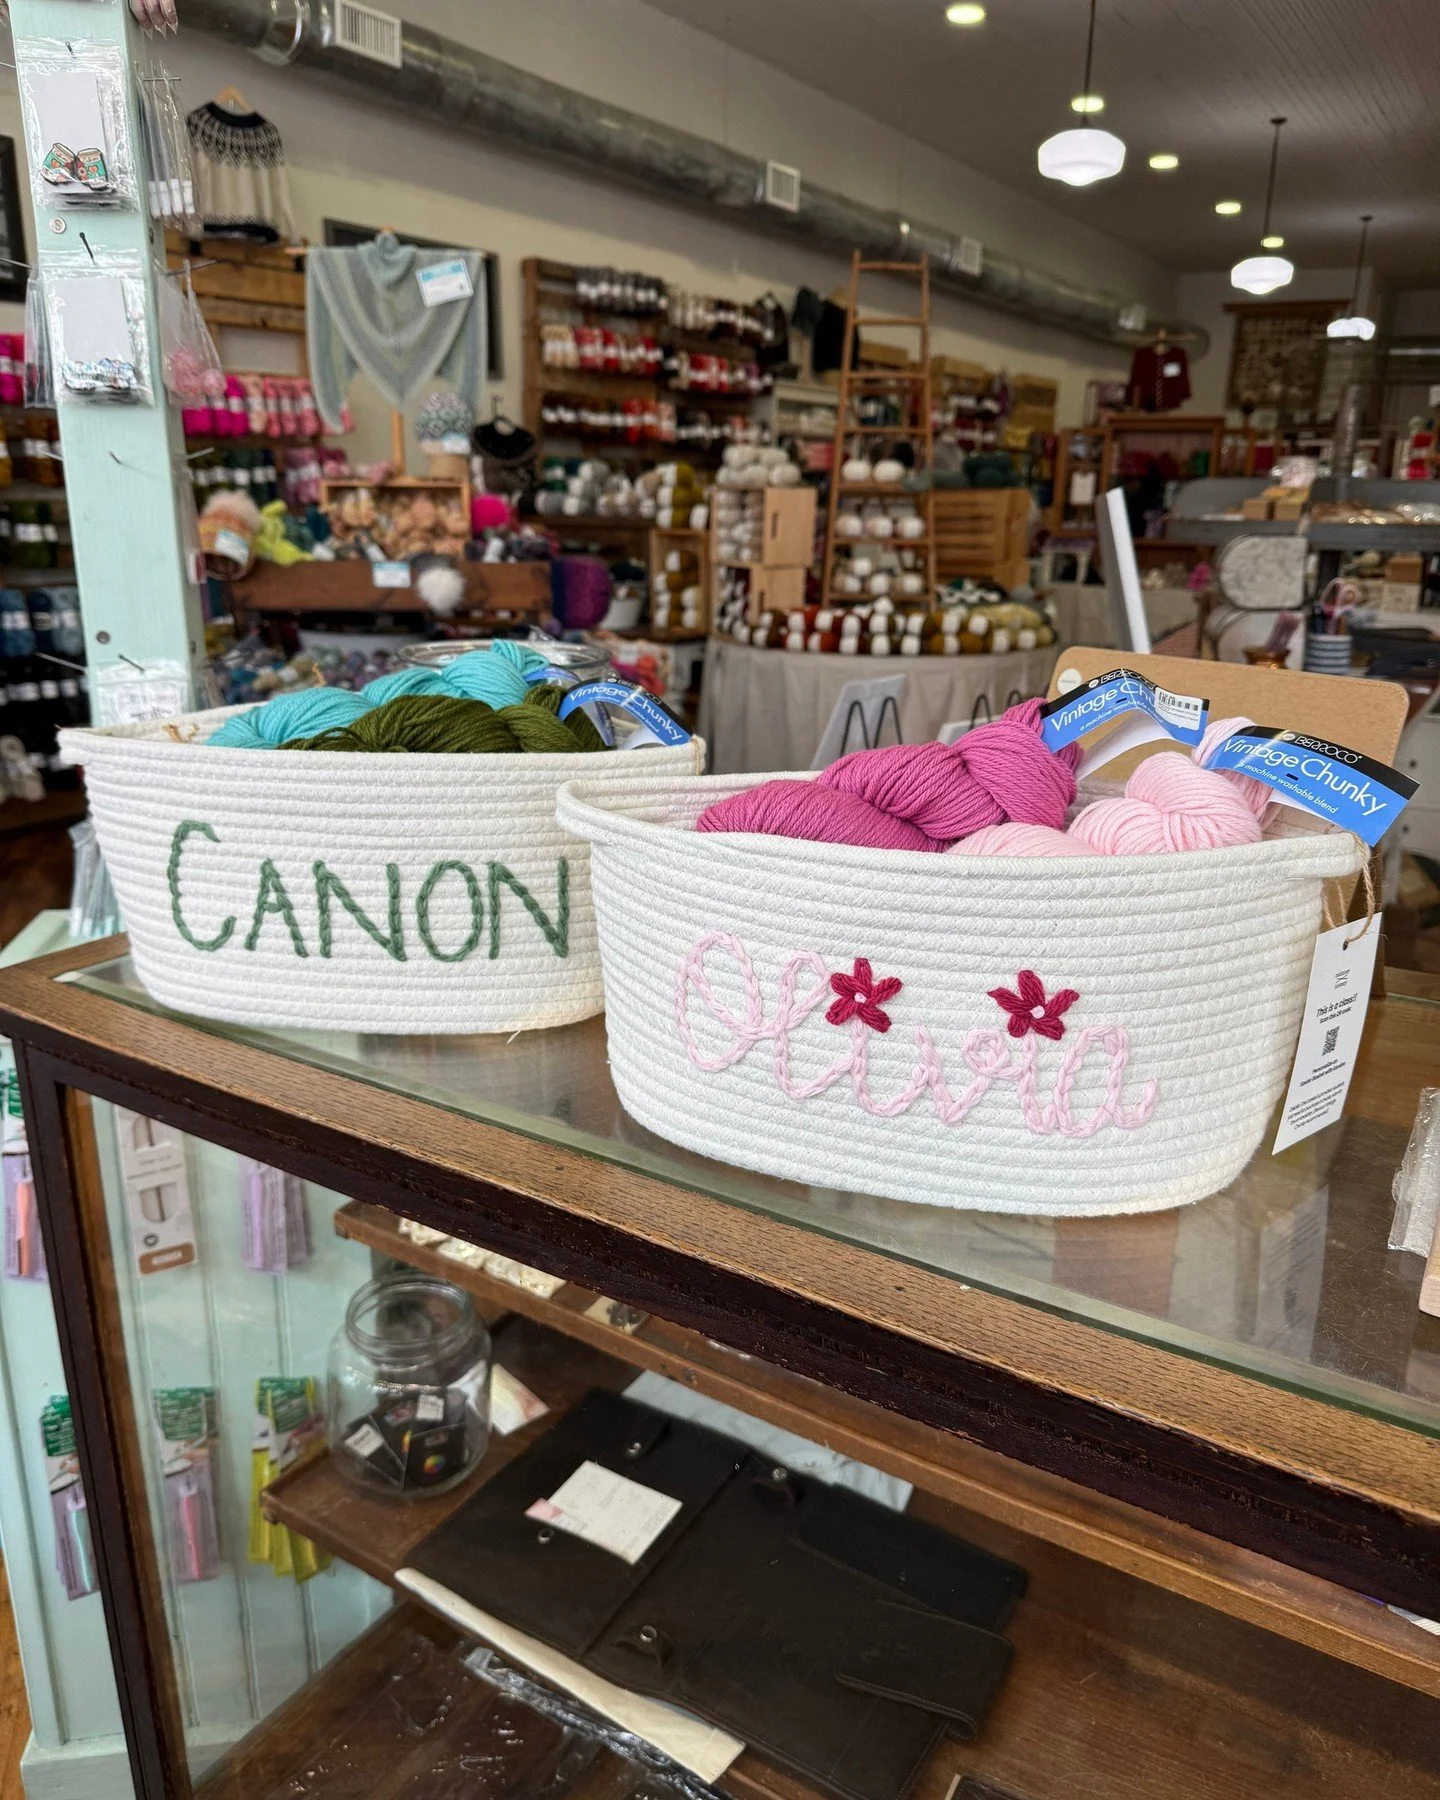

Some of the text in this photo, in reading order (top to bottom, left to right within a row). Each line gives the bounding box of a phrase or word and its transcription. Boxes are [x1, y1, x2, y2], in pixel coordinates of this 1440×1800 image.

[570, 685, 682, 740] Vintage Chunky
[1051, 689, 1117, 732] Vintage
[1085, 710, 1112, 727] machine
[1222, 739, 1388, 816] Vintage Chunky
[1244, 764, 1278, 780] machine
[1278, 778, 1314, 801] washable
[1314, 796, 1340, 814] blend
[675, 929, 1160, 1138] Olivia
[1317, 1004, 1328, 1017] This
[1328, 1002, 1334, 1012] is
